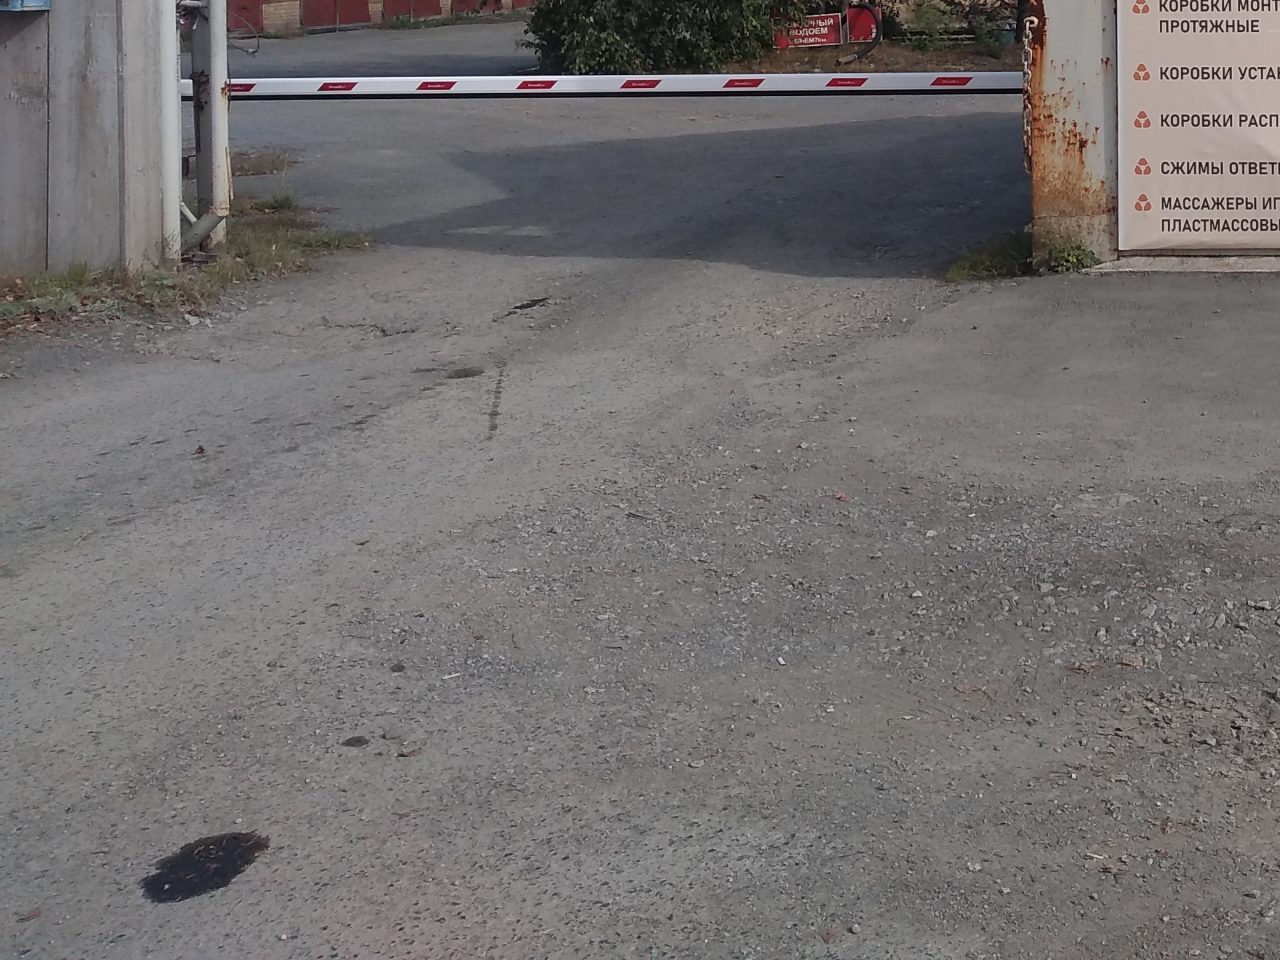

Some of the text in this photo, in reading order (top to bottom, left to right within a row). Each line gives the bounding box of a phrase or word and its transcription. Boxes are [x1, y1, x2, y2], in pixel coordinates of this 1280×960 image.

[1159, 0, 1232, 13] КОРОБКИ
[1159, 19, 1260, 33] ПРОТЯЖНЫЕ
[1159, 66, 1233, 80] КОРОБКИ
[1160, 114, 1233, 128] КОРОБКИ
[1160, 161, 1224, 175] СЖИМЫ
[1161, 197, 1258, 211] МАССАЖЕРЫ
